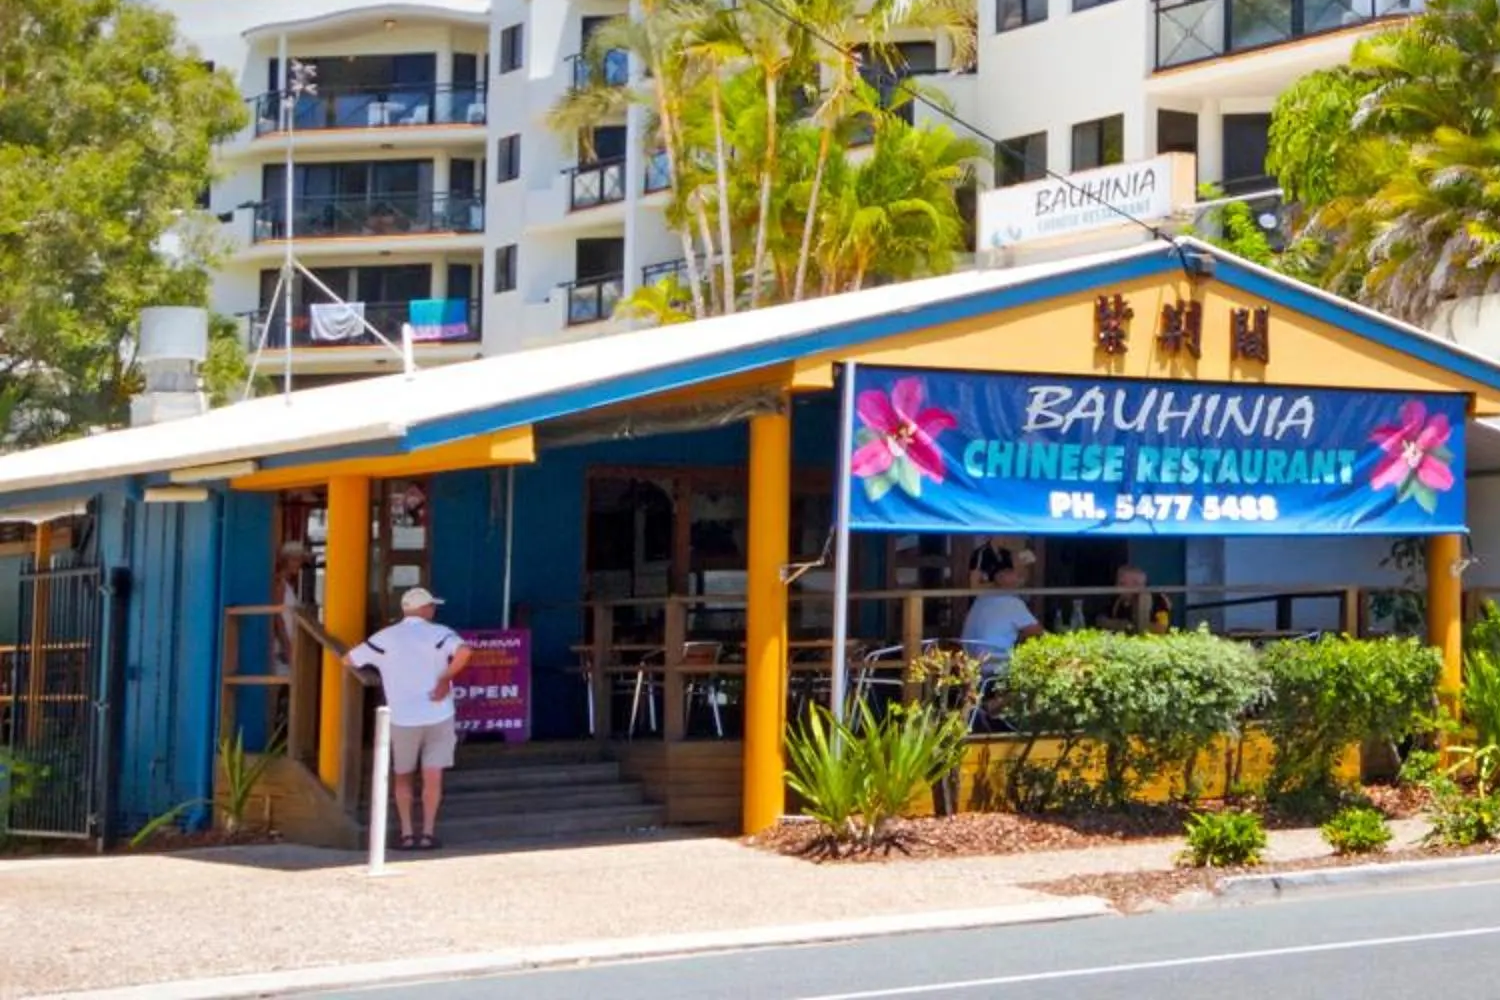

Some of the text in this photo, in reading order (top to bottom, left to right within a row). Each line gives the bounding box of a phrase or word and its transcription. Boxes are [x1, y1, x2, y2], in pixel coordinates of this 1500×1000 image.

[1035, 168, 1156, 216] BAUHINIA
[1023, 384, 1316, 440] BAUHINIA
[963, 439, 1357, 485] CHINESE RESTAURANT
[1049, 491, 1279, 521] PH. 5477 5488
[453, 685, 520, 699] OPEN
